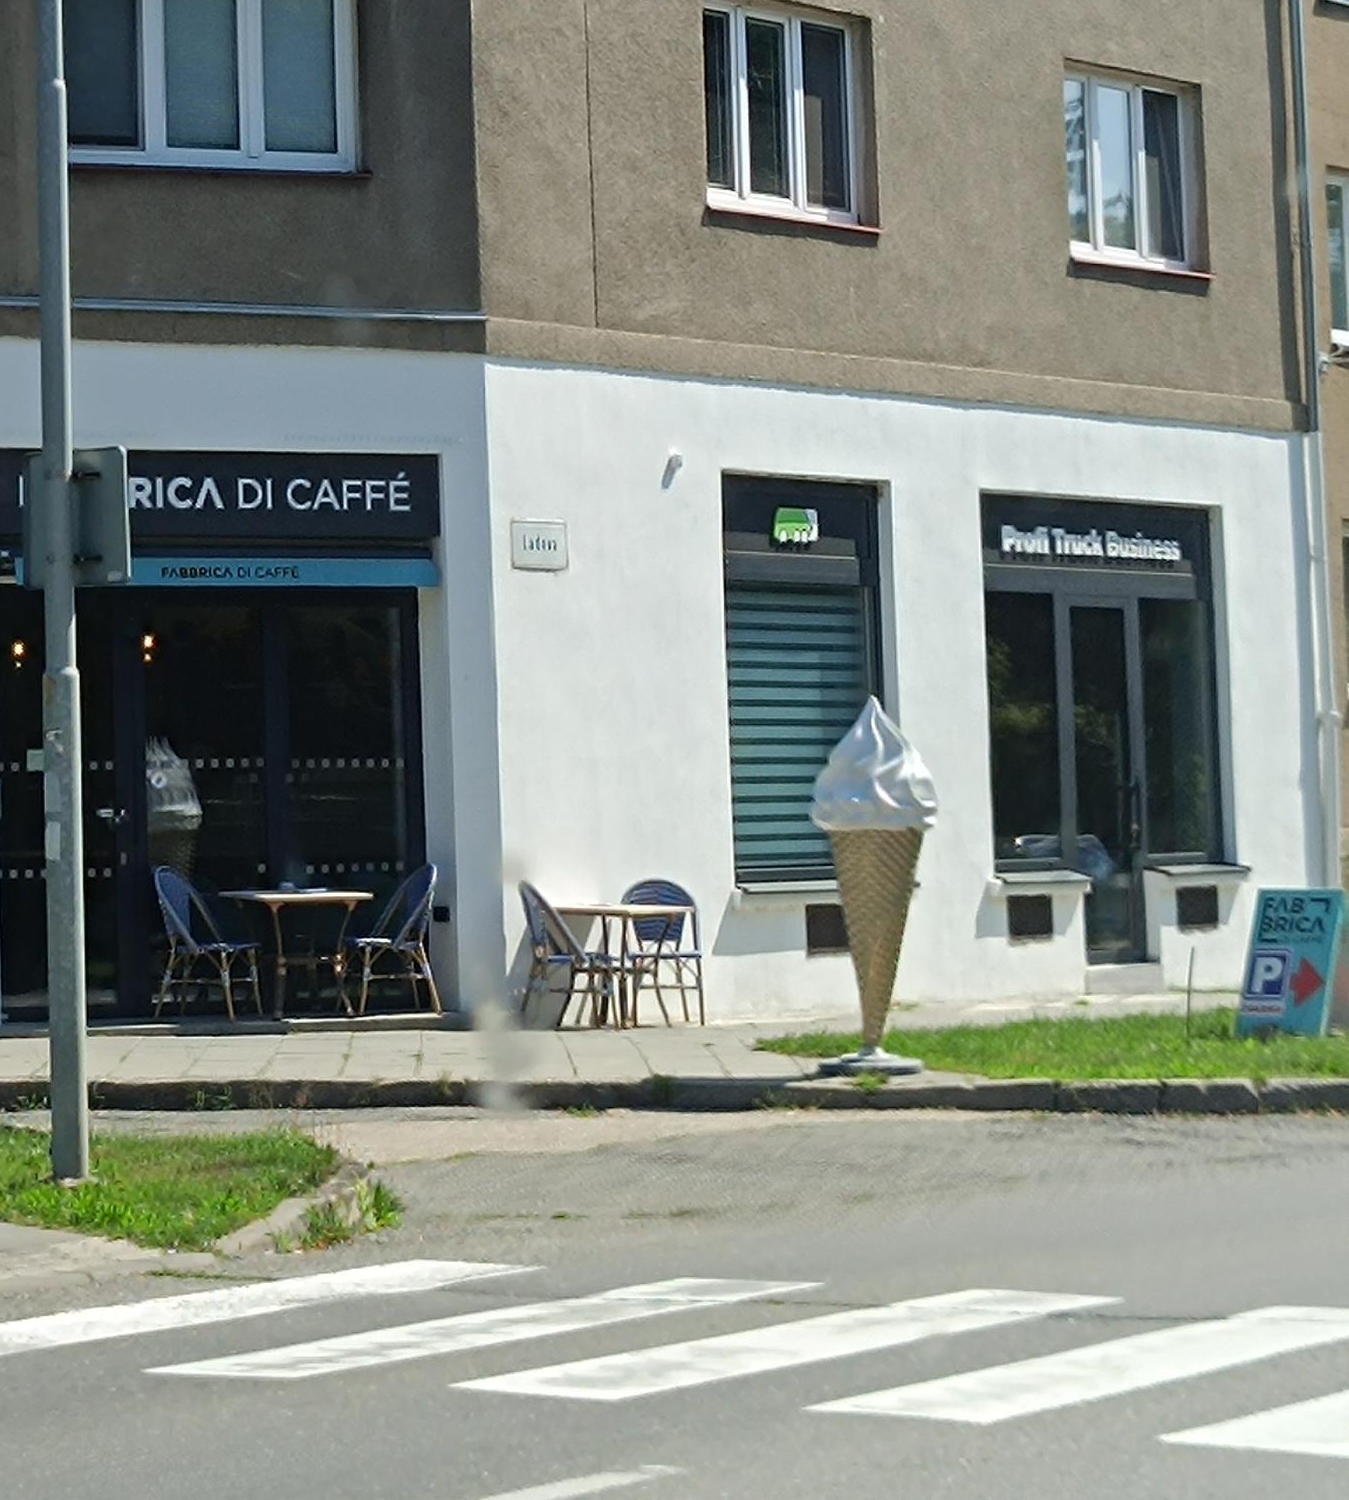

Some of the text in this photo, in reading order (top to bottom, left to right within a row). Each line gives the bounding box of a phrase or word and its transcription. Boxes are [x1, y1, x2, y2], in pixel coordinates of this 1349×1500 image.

[237, 477, 273, 510] DI
[287, 471, 411, 512] CAFFÉ
[1001, 524, 1182, 561] Profi Truck Business
[160, 566, 234, 579] FABBRICA
[236, 566, 252, 579] DI
